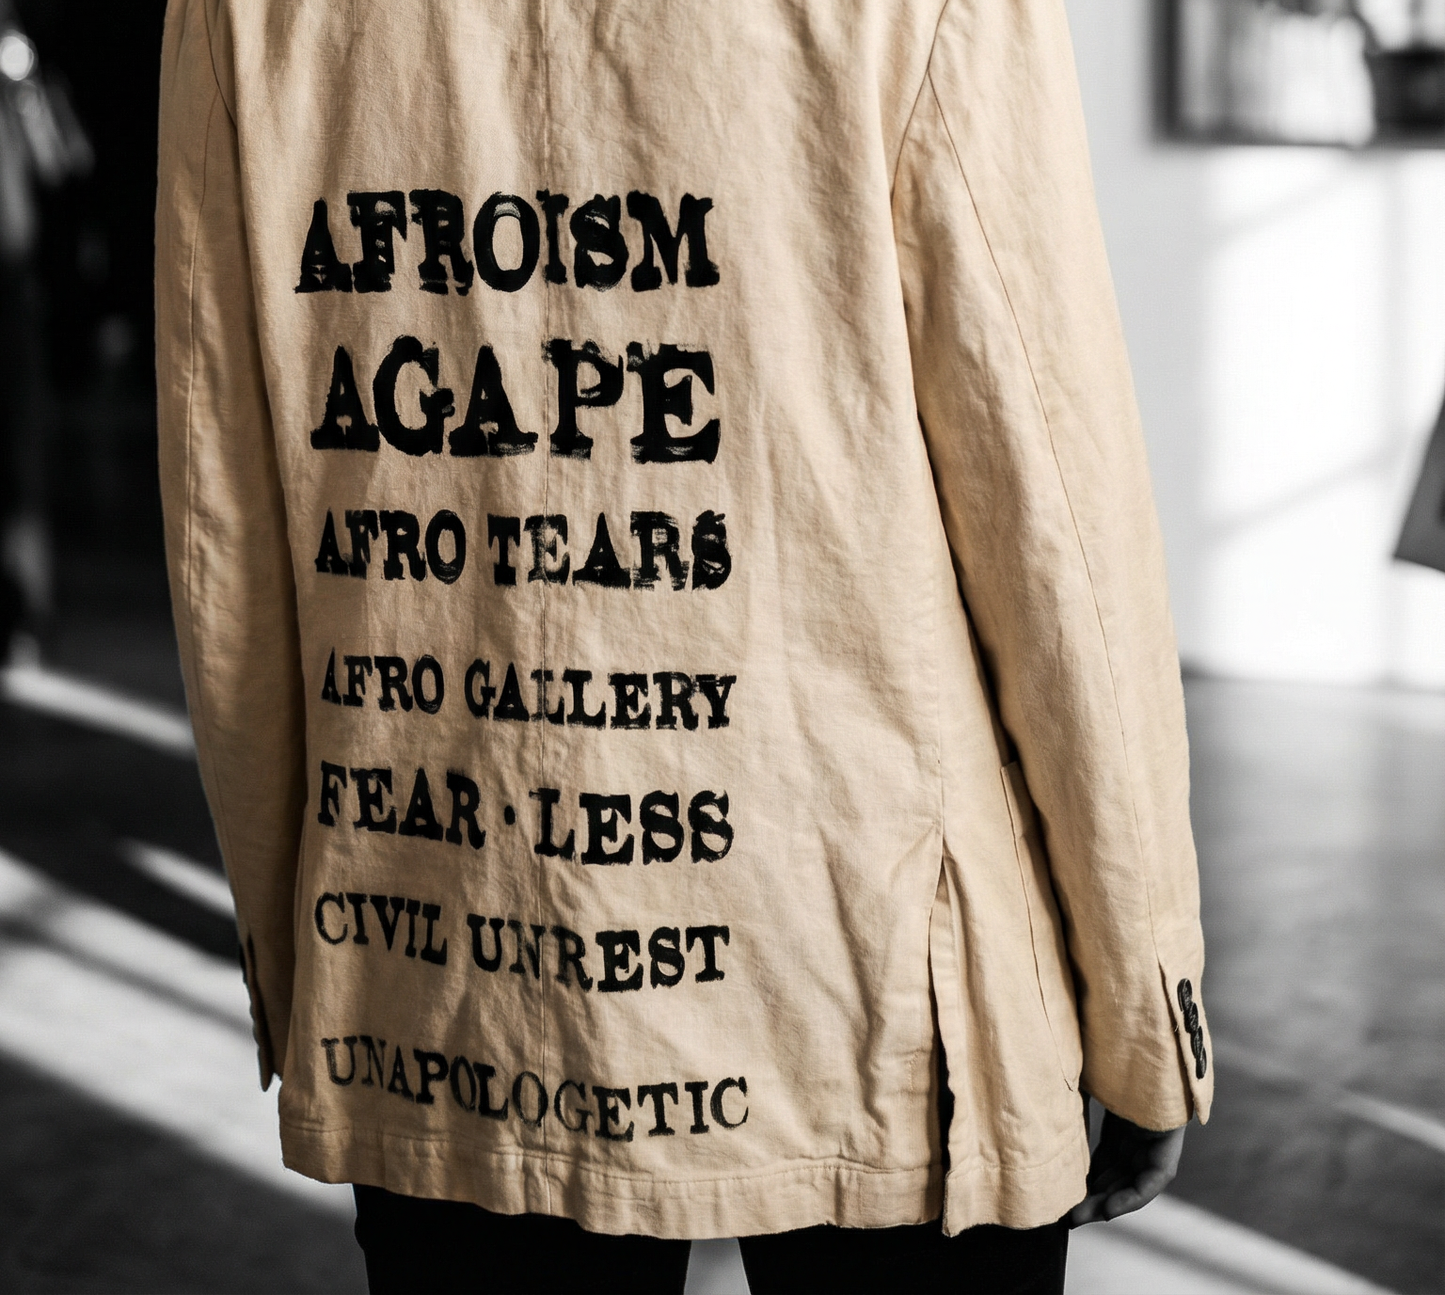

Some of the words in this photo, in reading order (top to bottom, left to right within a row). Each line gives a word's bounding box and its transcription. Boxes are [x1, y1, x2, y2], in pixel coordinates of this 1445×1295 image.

[294, 188, 721, 296] AFROISM
[310, 335, 721, 465] AGAPE
[314, 506, 467, 586] AFRO
[487, 509, 732, 592] TEARS
[321, 647, 445, 715] AFRO
[464, 658, 737, 731] GALLERY
[314, 892, 447, 966] CIVIL
[467, 913, 731, 993] UNREST
[320, 1035, 749, 1142] UNAPOLOGETIC
